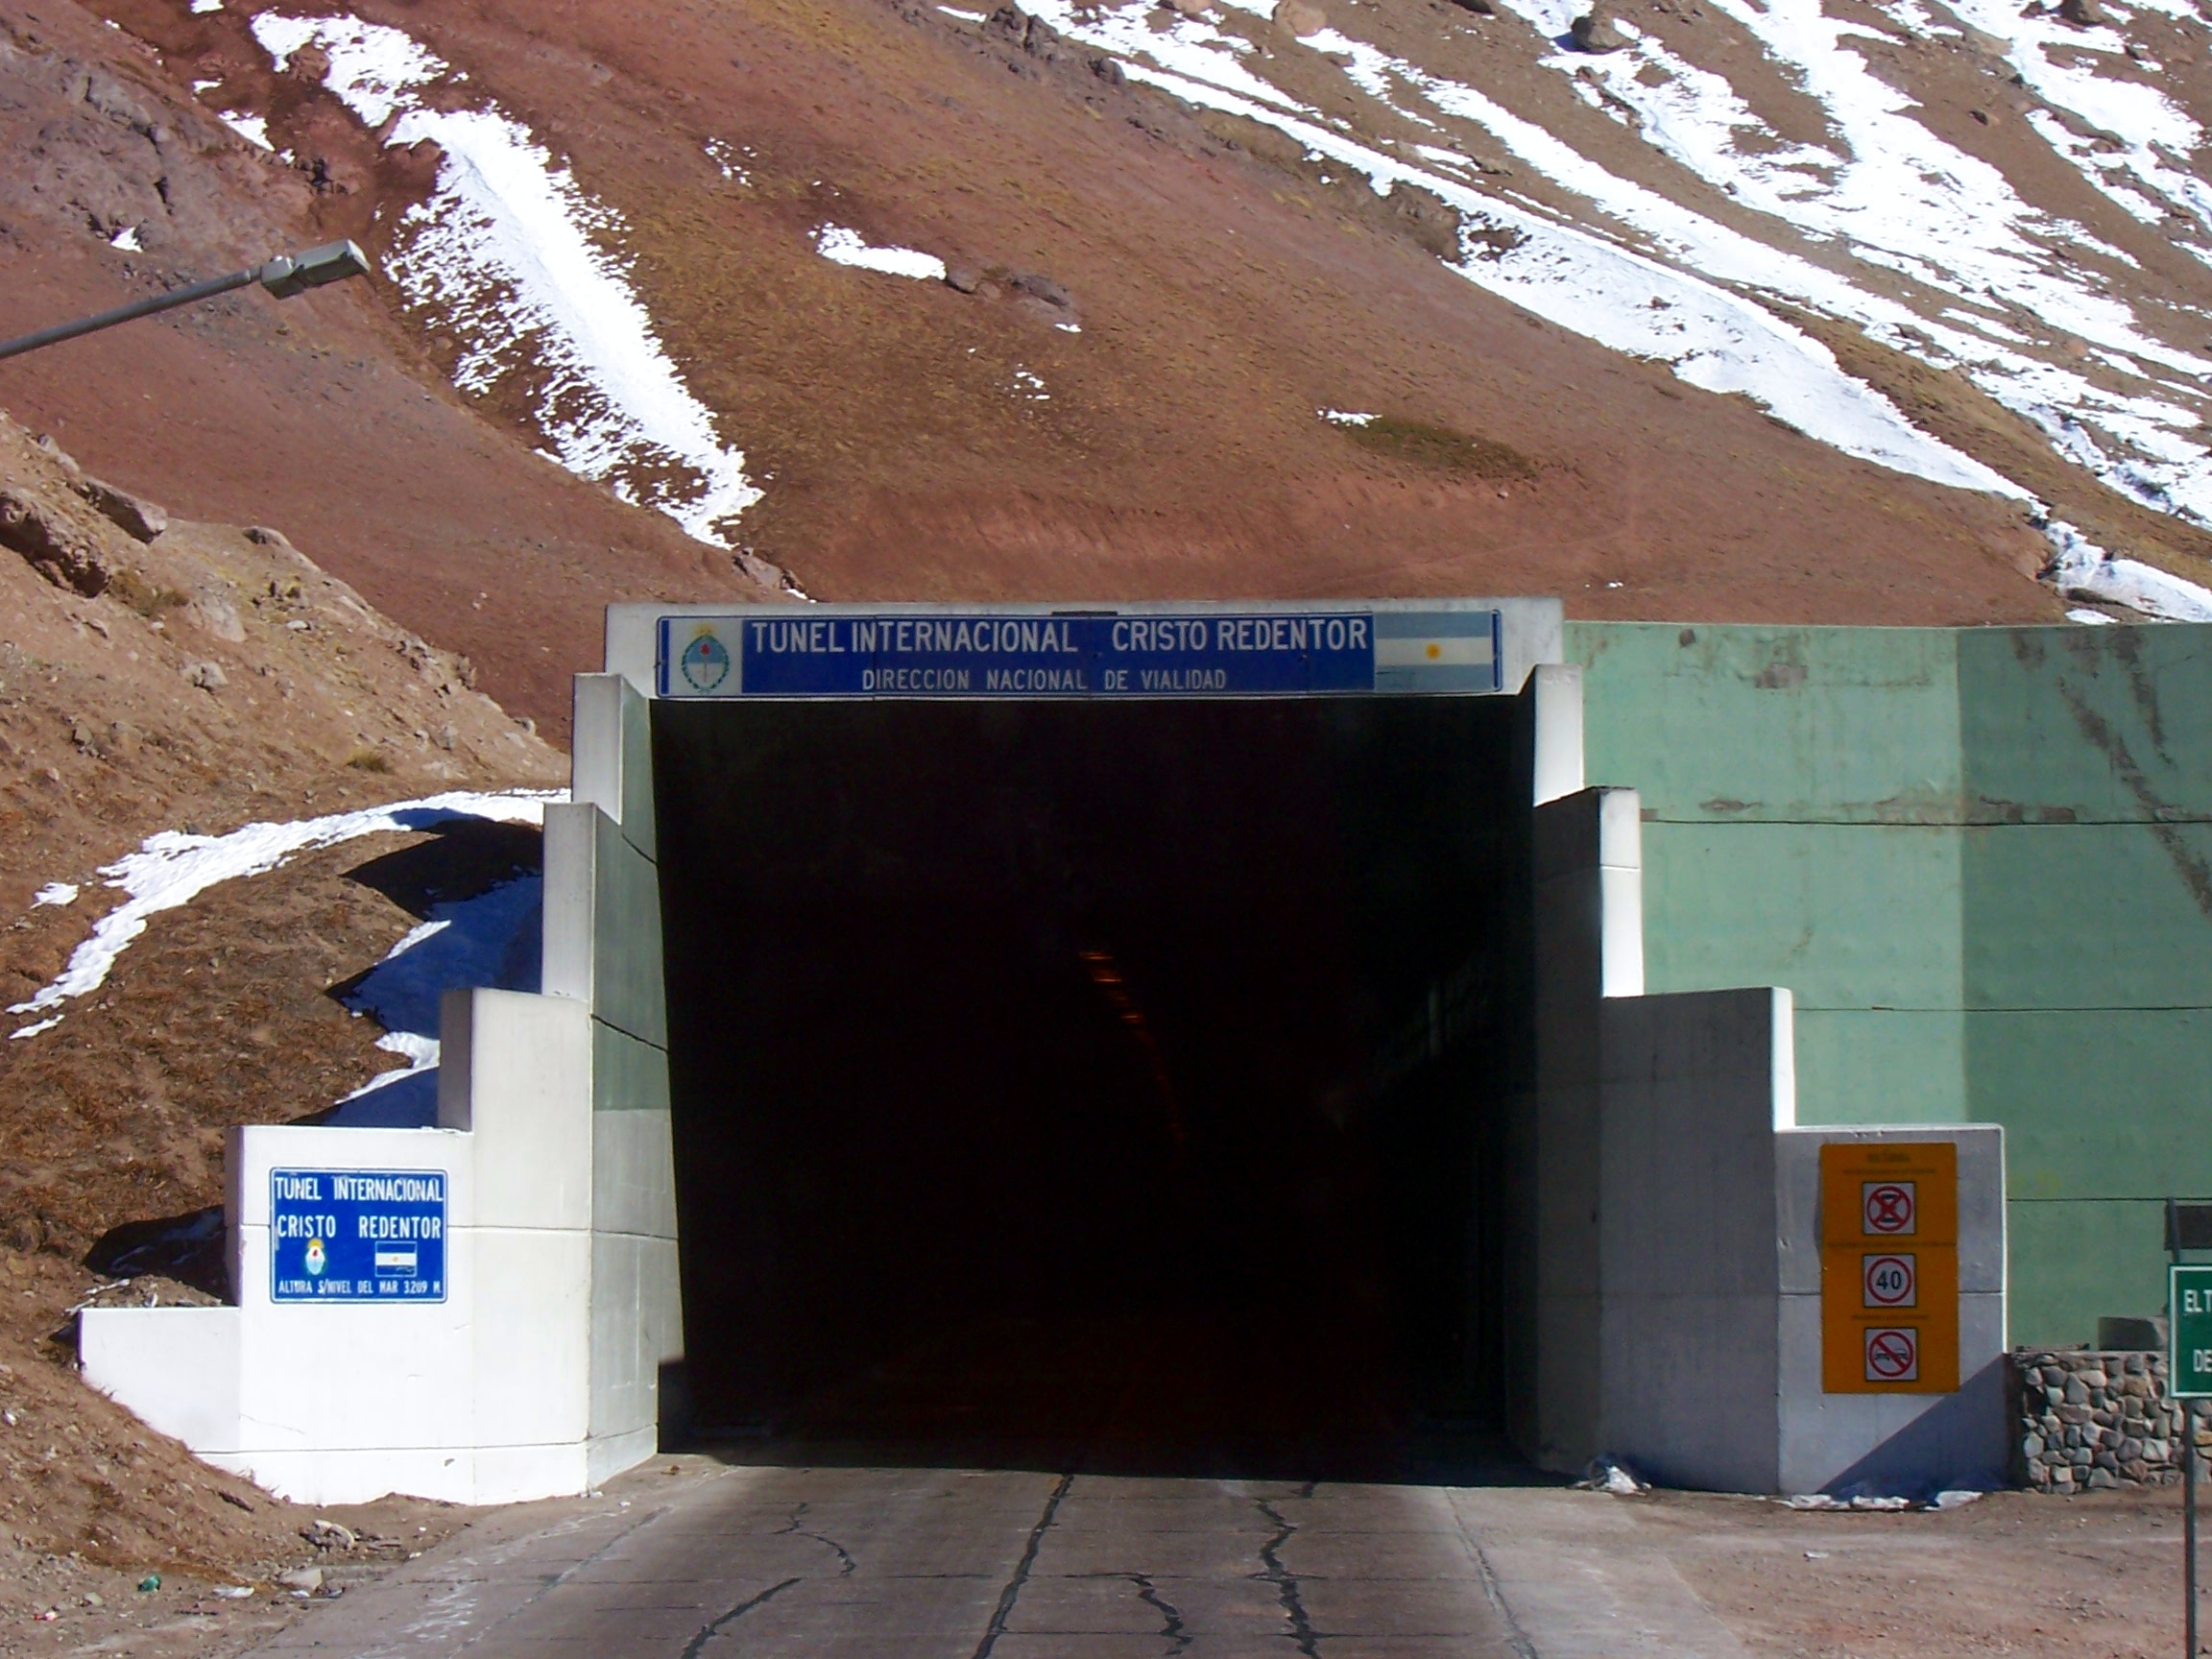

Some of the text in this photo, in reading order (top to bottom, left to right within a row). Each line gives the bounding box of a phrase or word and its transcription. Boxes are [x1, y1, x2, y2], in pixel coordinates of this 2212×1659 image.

[752, 617, 1368, 654] TUNEL INTERNACIONAL CRISTO REDENTOR
[862, 668, 1227, 691] DIRECCION NACIONAL DE VIALIDAD
[275, 1177, 444, 1202] TUNEL INTERNACIONAL
[276, 1214, 442, 1239] CRISTO REDENTOR
[277, 1280, 313, 1294] ALTURA
[357, 1280, 374, 1294] DEL
[378, 1280, 398, 1294] MAR
[1875, 1269, 1903, 1290] 40
